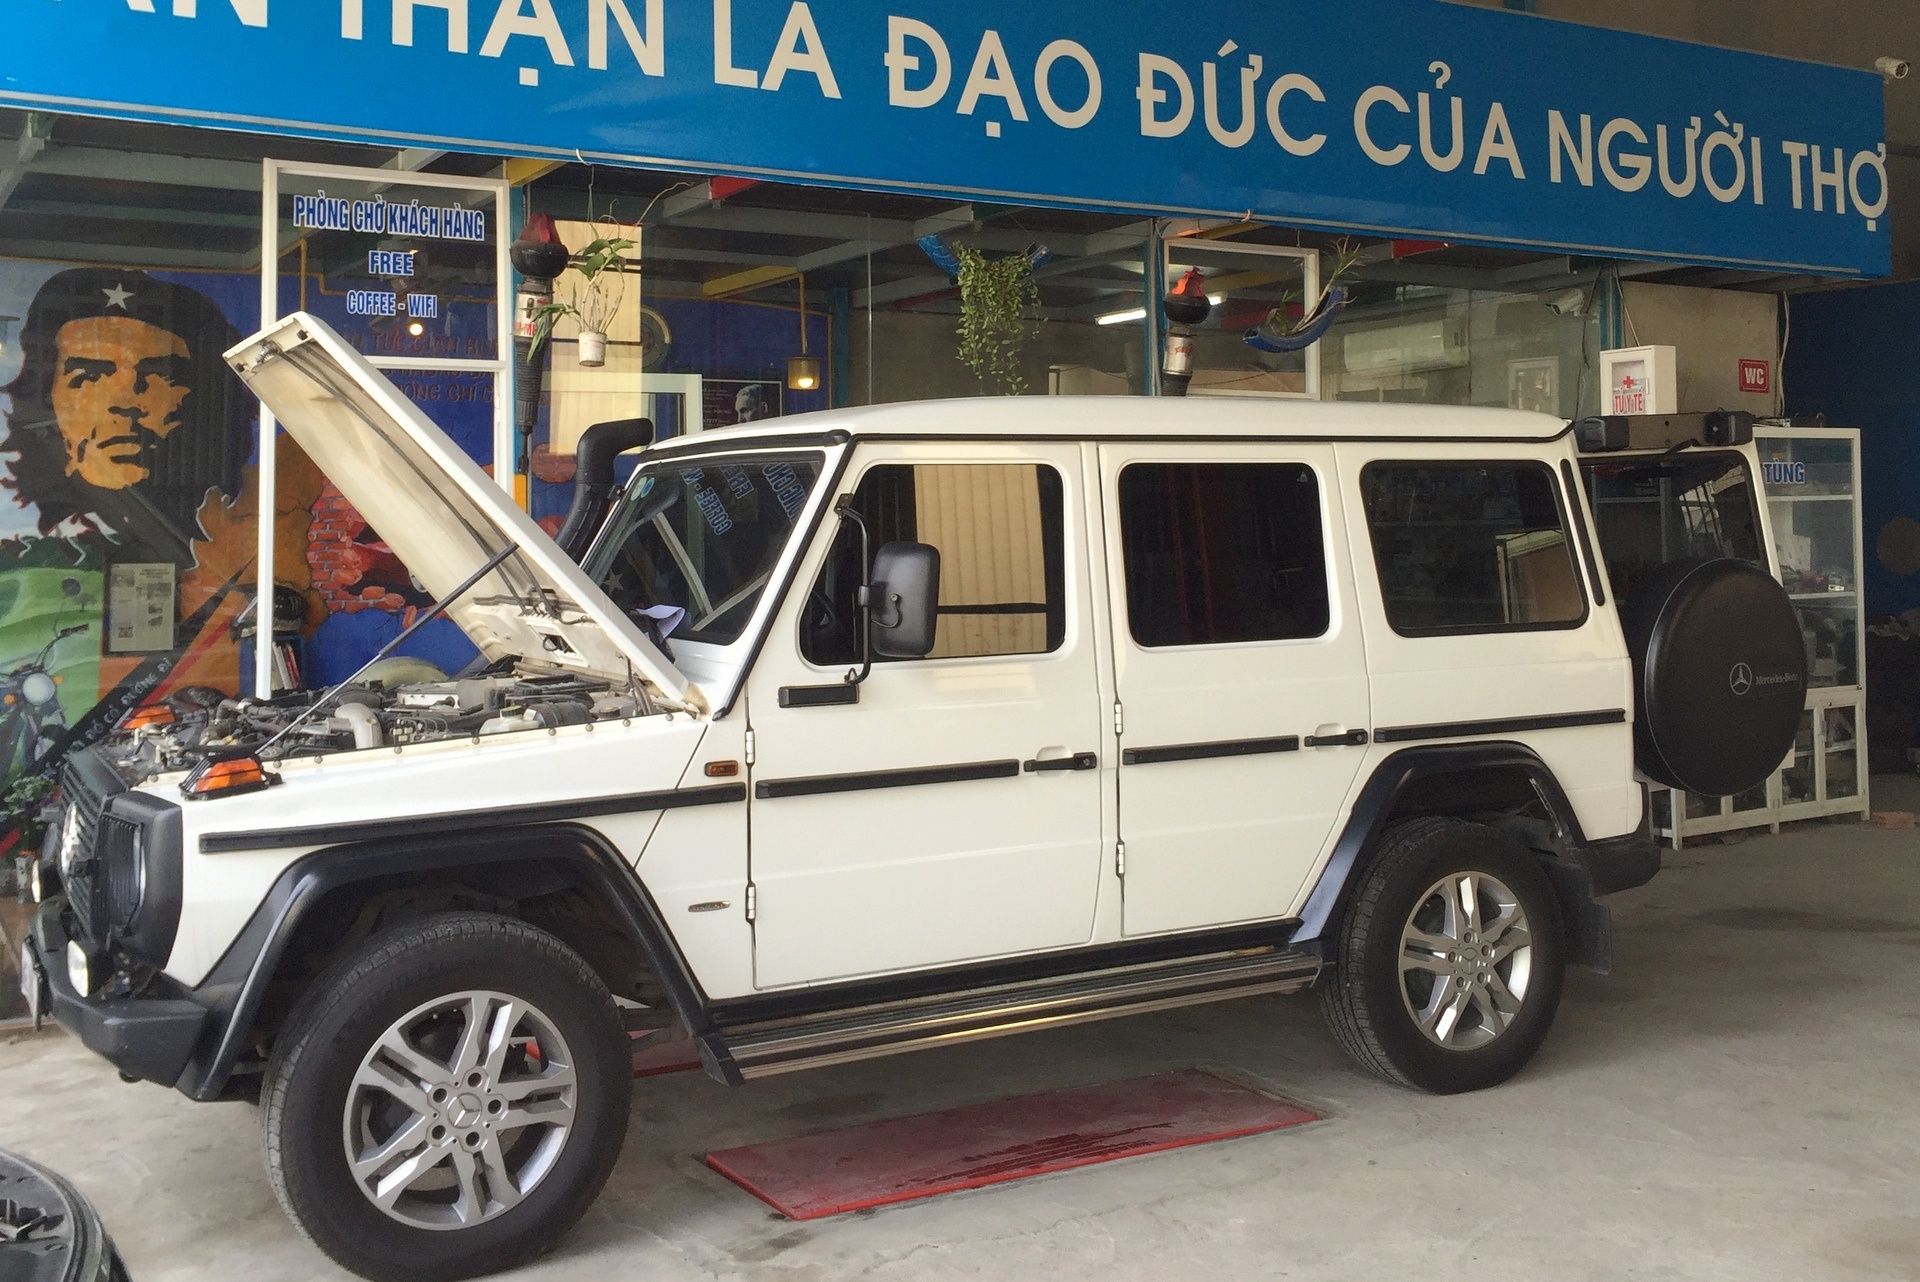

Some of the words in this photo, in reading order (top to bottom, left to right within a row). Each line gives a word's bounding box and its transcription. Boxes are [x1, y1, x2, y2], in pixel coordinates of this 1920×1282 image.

[885, 16, 1101, 137] ĐẠO
[1137, 40, 1327, 156] ĐỨC
[1355, 62, 1526, 179] CỦA
[1549, 110, 1763, 205] NGƯỜI
[1782, 142, 1888, 232] THỢ
[293, 189, 350, 231] PHÒNG
[352, 194, 387, 234] CHỜ
[387, 199, 441, 238] KHÁCH
[442, 202, 485, 241] HÀNG
[368, 250, 414, 276] FREE
[347, 290, 396, 316] COFFEE
[406, 294, 437, 318] WIFI
[1744, 367, 1765, 385] WC
[1762, 457, 1806, 484] TÙNG
